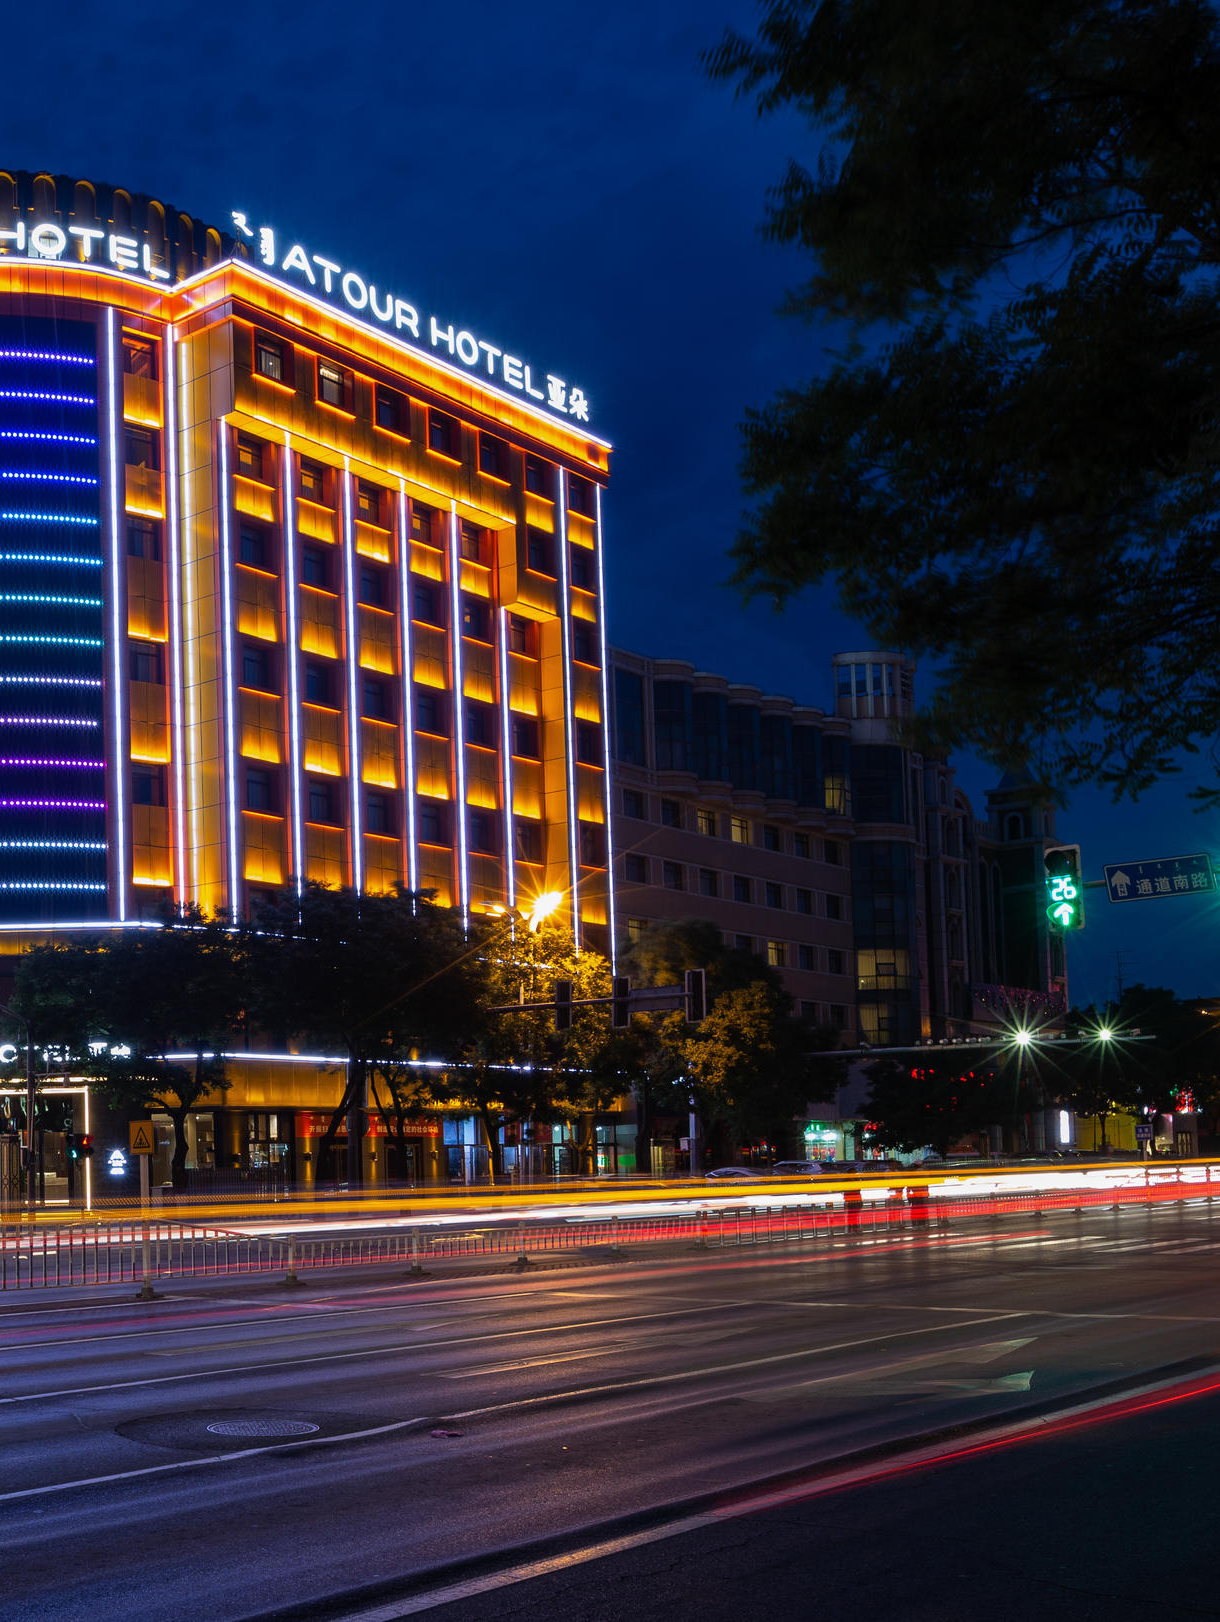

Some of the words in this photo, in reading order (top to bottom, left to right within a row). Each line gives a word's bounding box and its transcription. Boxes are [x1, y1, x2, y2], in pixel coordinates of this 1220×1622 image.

[281, 244, 421, 338] ATOUR
[430, 316, 545, 400] HOTEL
[546, 374, 589, 422] 亚朵
[1136, 872, 1208, 895] 通道南路
